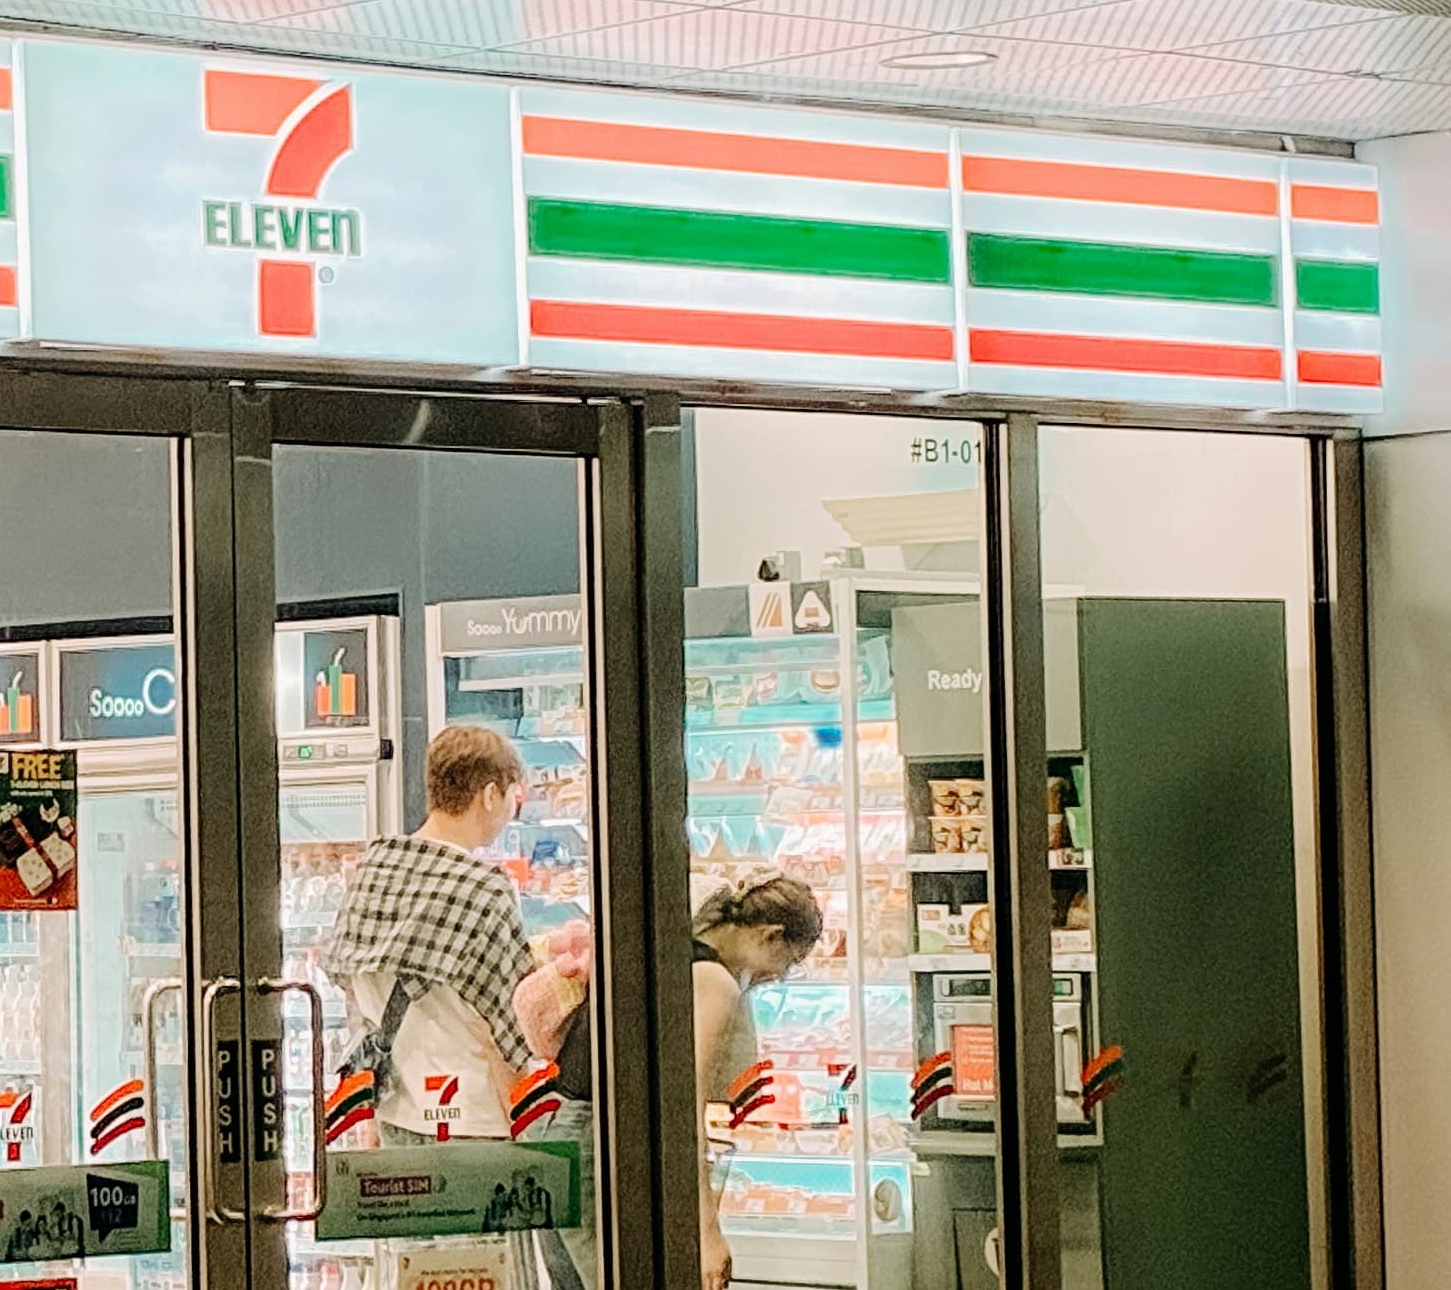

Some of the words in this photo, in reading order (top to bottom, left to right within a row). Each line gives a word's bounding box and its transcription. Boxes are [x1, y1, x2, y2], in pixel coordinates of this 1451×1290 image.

[203, 68, 352, 336] 7
[910, 438, 982, 464] #B1-01
[927, 668, 983, 693] Ready
[11, 753, 63, 780] FREE
[217, 1050, 232, 1154] PUSH
[262, 1049, 278, 1152] PUSH
[425, 1076, 458, 1142] 7
[364, 1178, 405, 1195] Tourist
[406, 1177, 430, 1192] SIM
